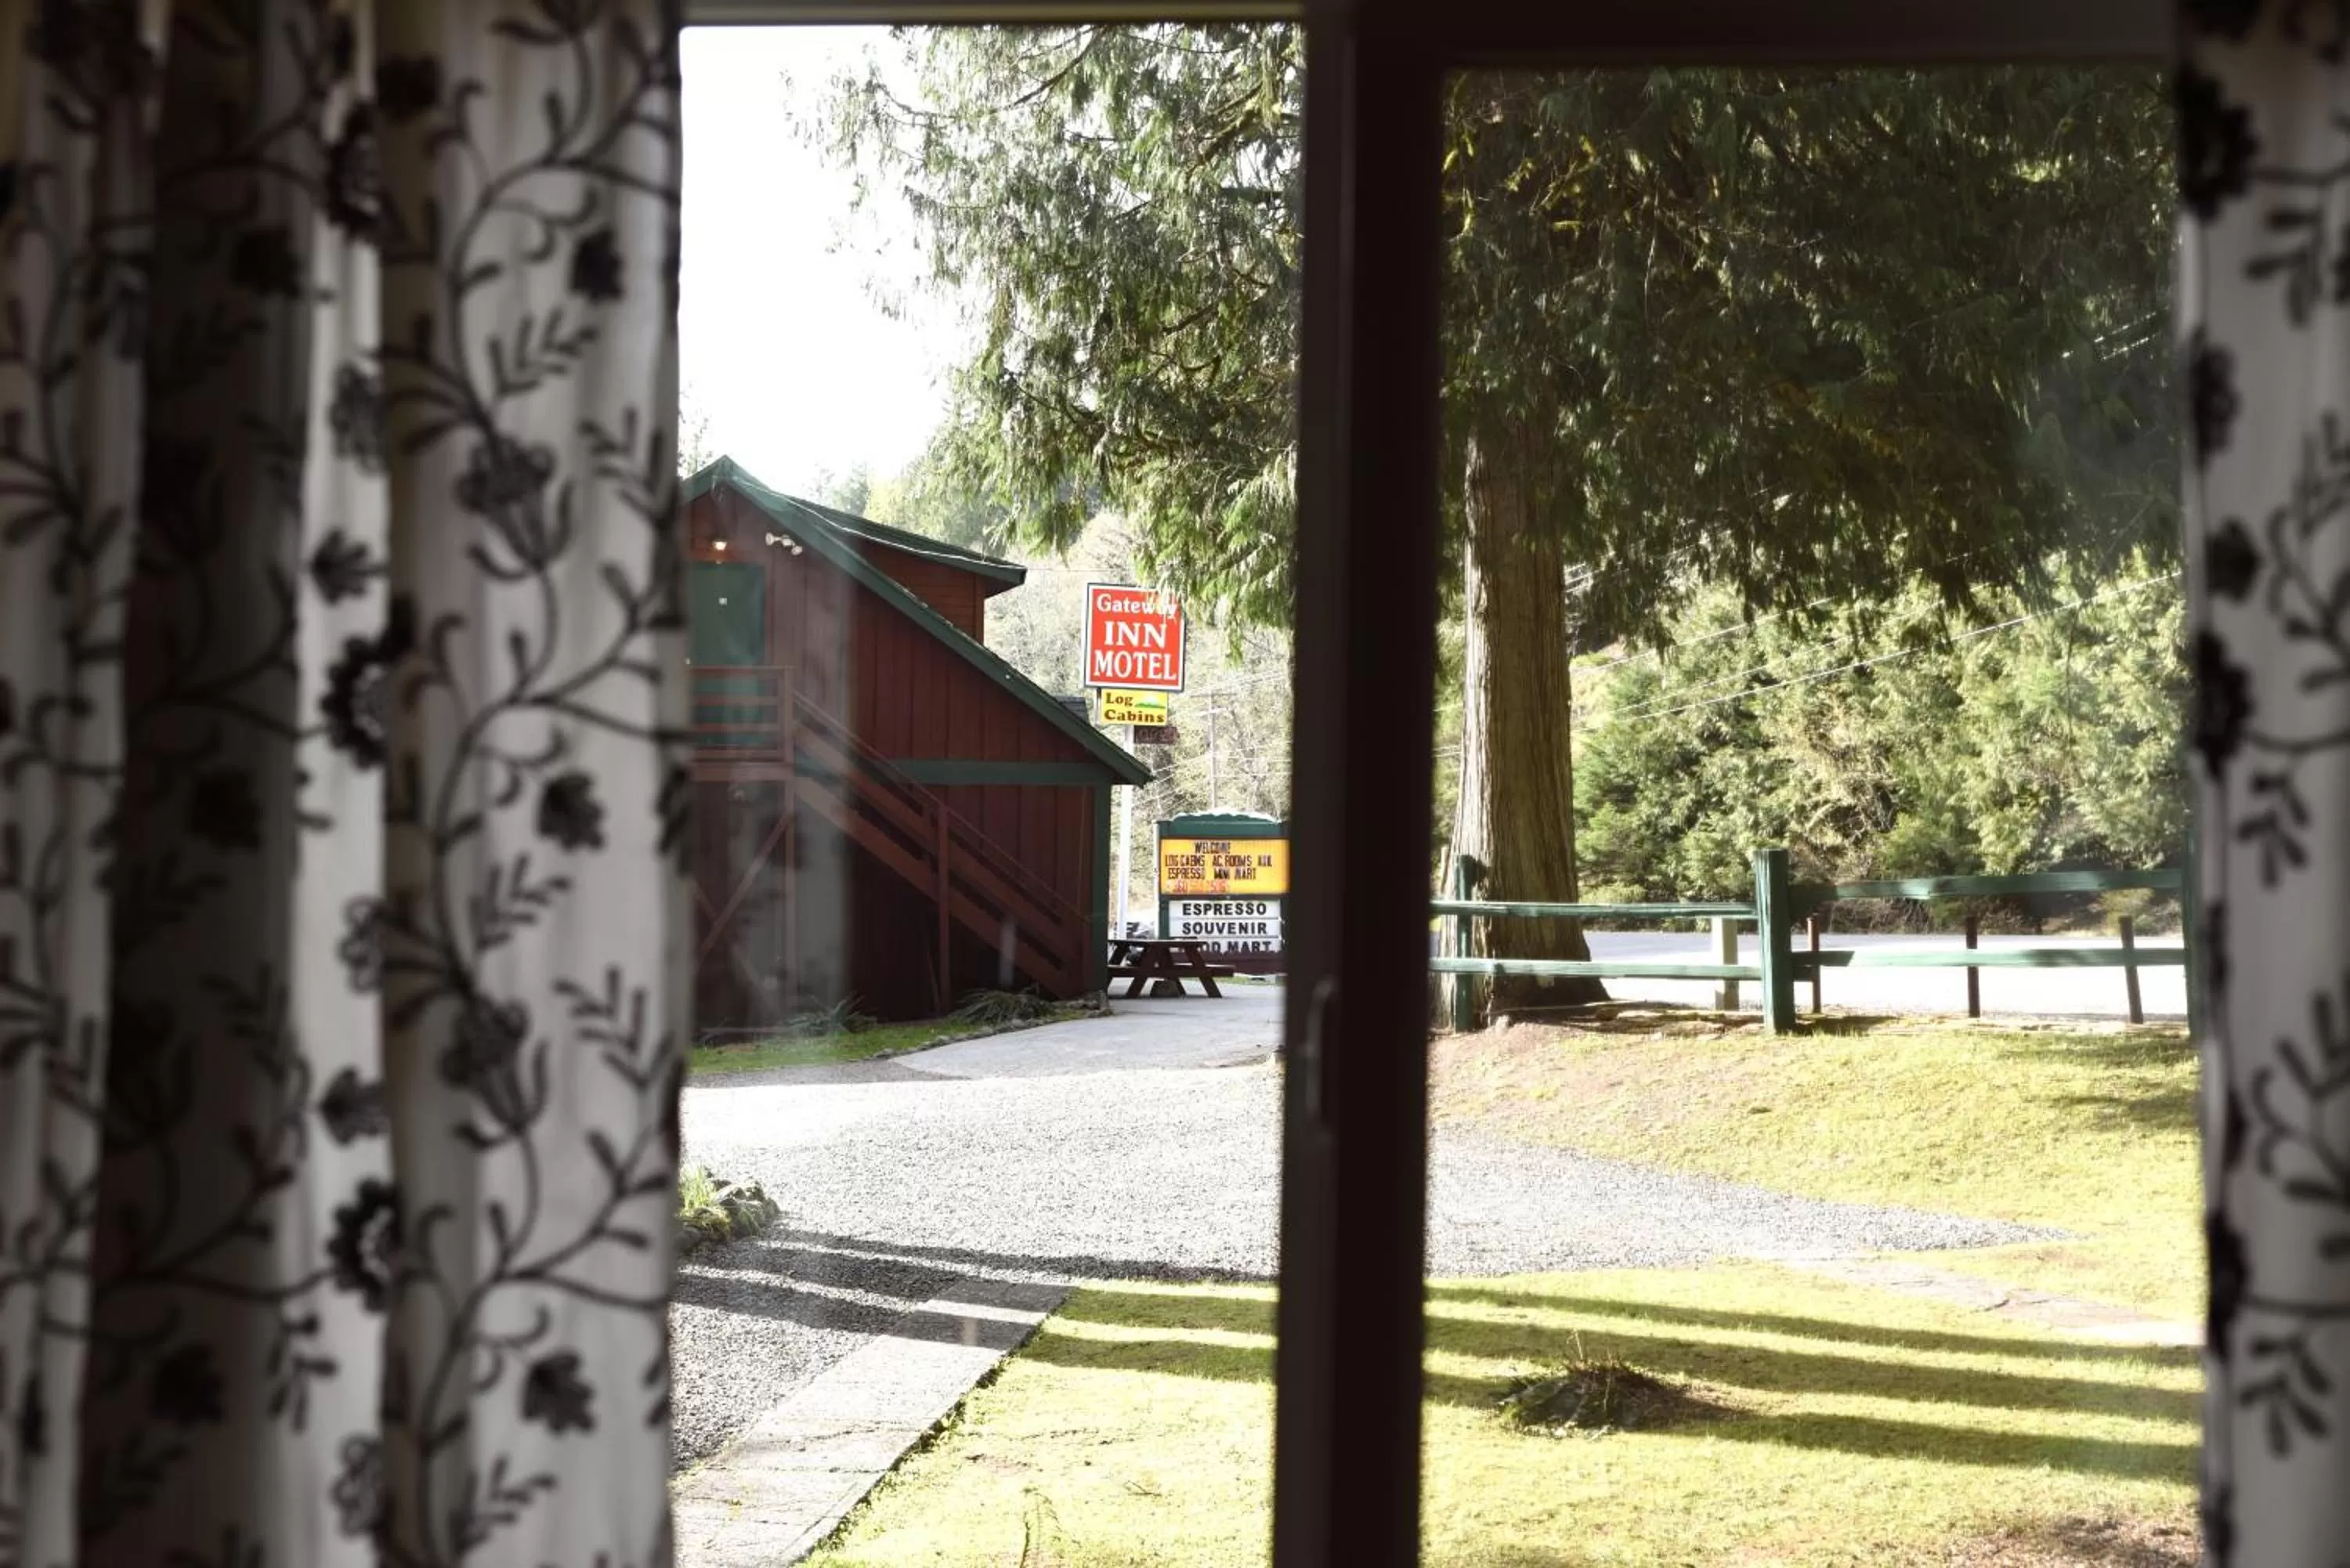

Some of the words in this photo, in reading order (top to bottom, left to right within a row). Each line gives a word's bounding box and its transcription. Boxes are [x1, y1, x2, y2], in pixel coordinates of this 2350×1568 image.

[1097, 593, 1177, 619] Gatewy
[1104, 621, 1167, 649] INN
[1094, 650, 1177, 680] MOTEL
[1105, 692, 1133, 706] Log
[1104, 709, 1165, 722] Cabins
[1182, 903, 1267, 916] ESPRESSO
[1182, 922, 1267, 934] SOUVENIR
